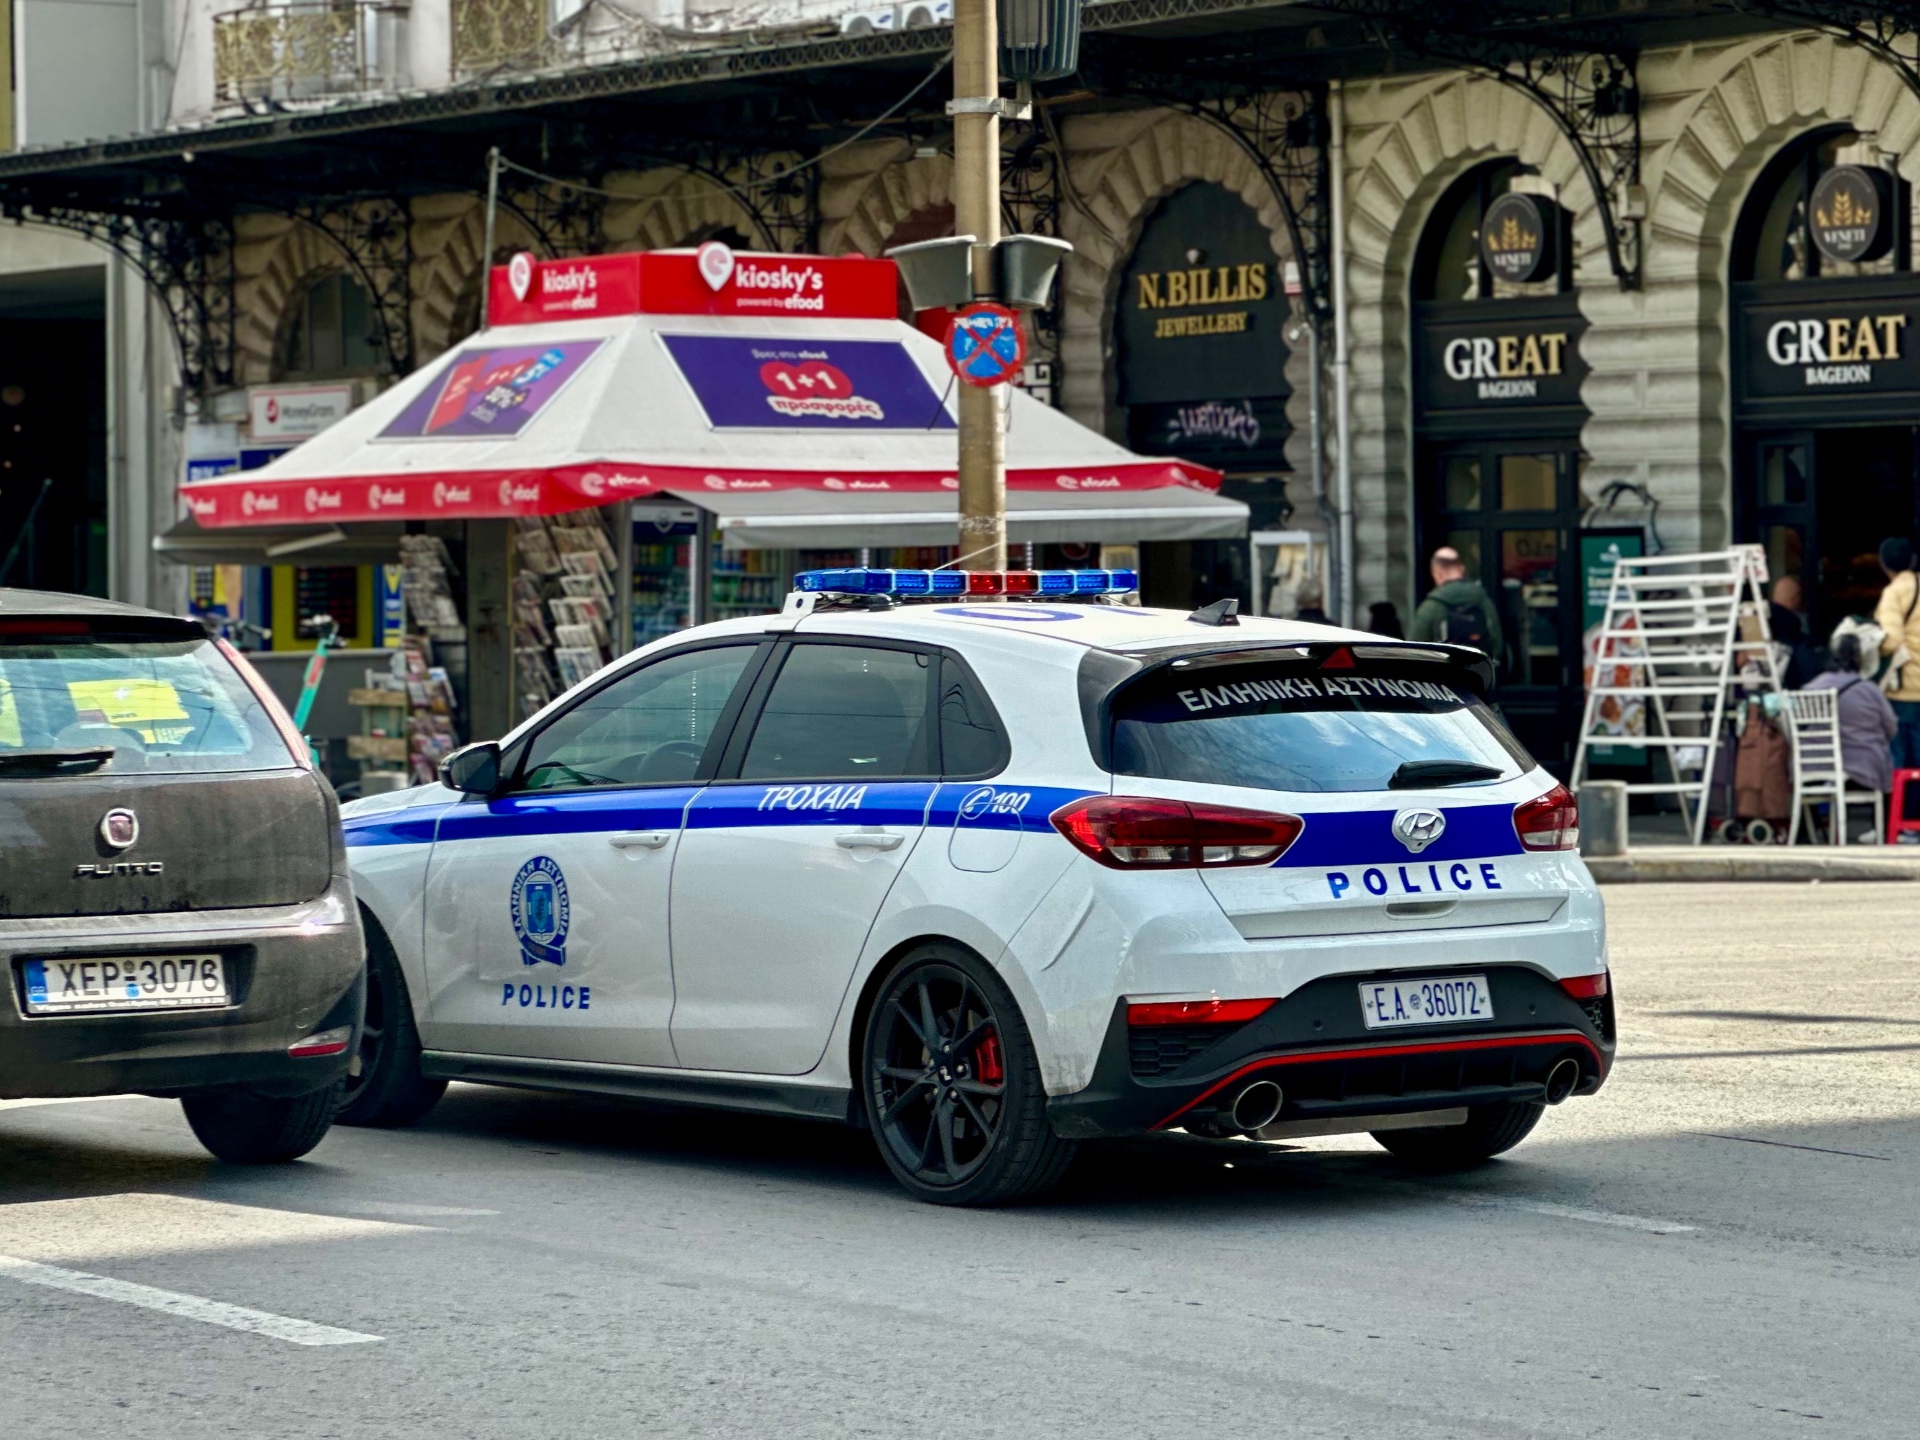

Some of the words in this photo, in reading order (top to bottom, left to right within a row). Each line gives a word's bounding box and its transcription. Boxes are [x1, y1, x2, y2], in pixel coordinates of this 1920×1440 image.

[542, 265, 597, 293] kiosky's
[735, 264, 824, 292] kiosky's
[1137, 261, 1267, 310] N.BILLIS
[736, 297, 766, 308] powered
[767, 298, 783, 309] by
[784, 294, 824, 311] efood
[1154, 311, 1248, 339] JEWELLERY
[1765, 313, 1906, 367] GREAT
[1443, 332, 1568, 381] GREAT
[775, 370, 838, 392] 1+1
[1804, 364, 1872, 386] BAGEION
[1080, 476, 1122, 488] efood
[1176, 677, 1323, 712] ΕΛΛΗΝΙΚΗ
[1321, 676, 1466, 705] ΑΣΤΥΝΟΜΙΑ
[757, 785, 869, 812] ΤΡΟΧΑΙΑ
[992, 792, 1032, 814] 100
[1325, 863, 1503, 900] POLICE
[501, 983, 591, 1010] POLICE
[1421, 980, 1481, 1019] 36072
